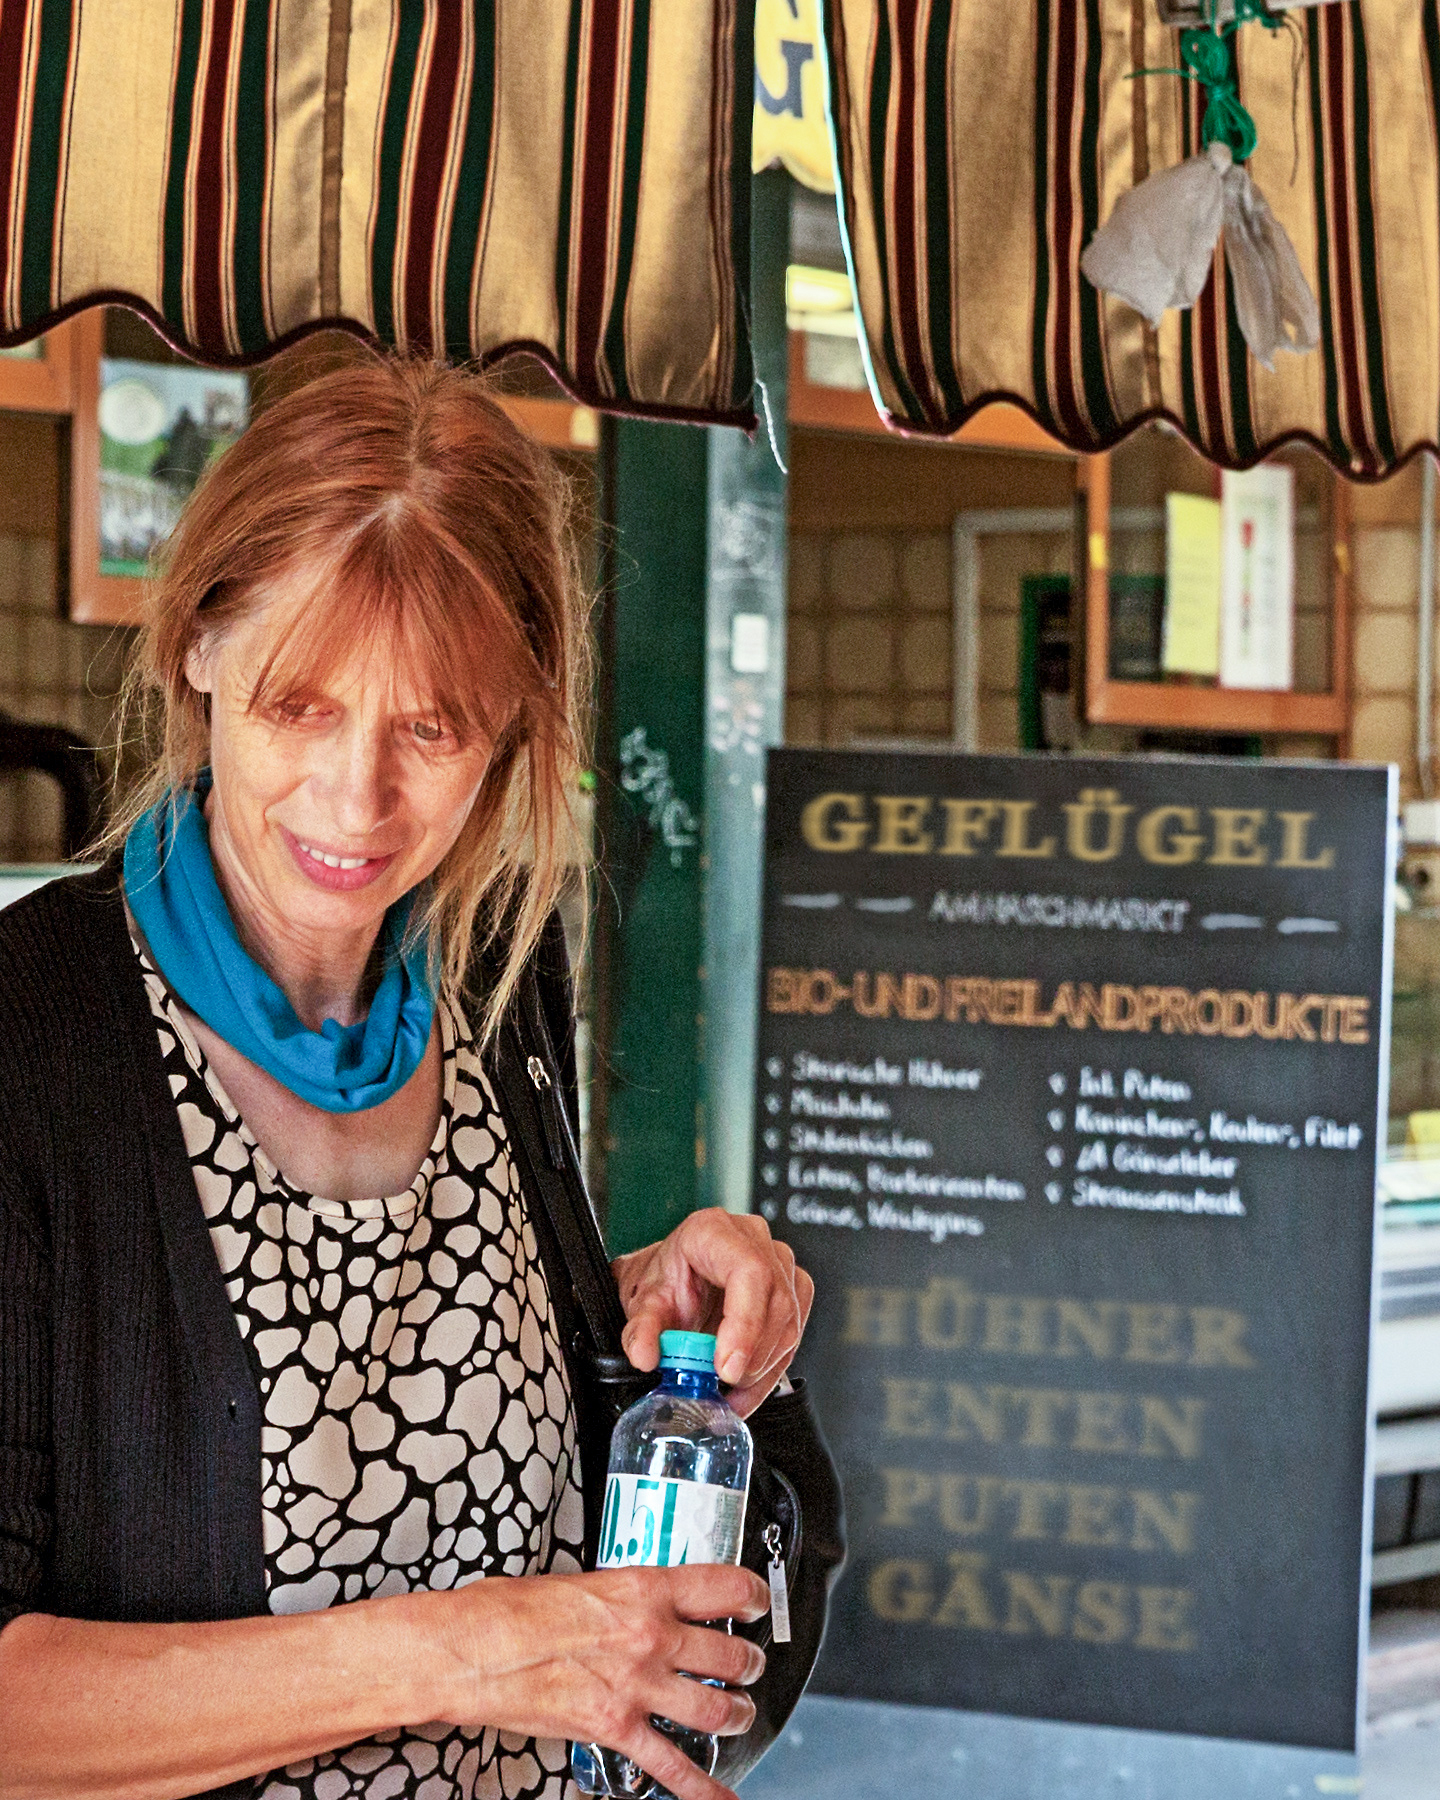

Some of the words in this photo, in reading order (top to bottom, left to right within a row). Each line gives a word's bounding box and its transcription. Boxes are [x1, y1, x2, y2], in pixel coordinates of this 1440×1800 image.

[801, 788, 1336, 869] GEFLÜGEL
[846, 1275, 1256, 1370] HÜHNER
[880, 1376, 1208, 1460] ENTEN
[876, 1467, 1202, 1557] PUTEN
[866, 1549, 1202, 1653] GÄNSE
